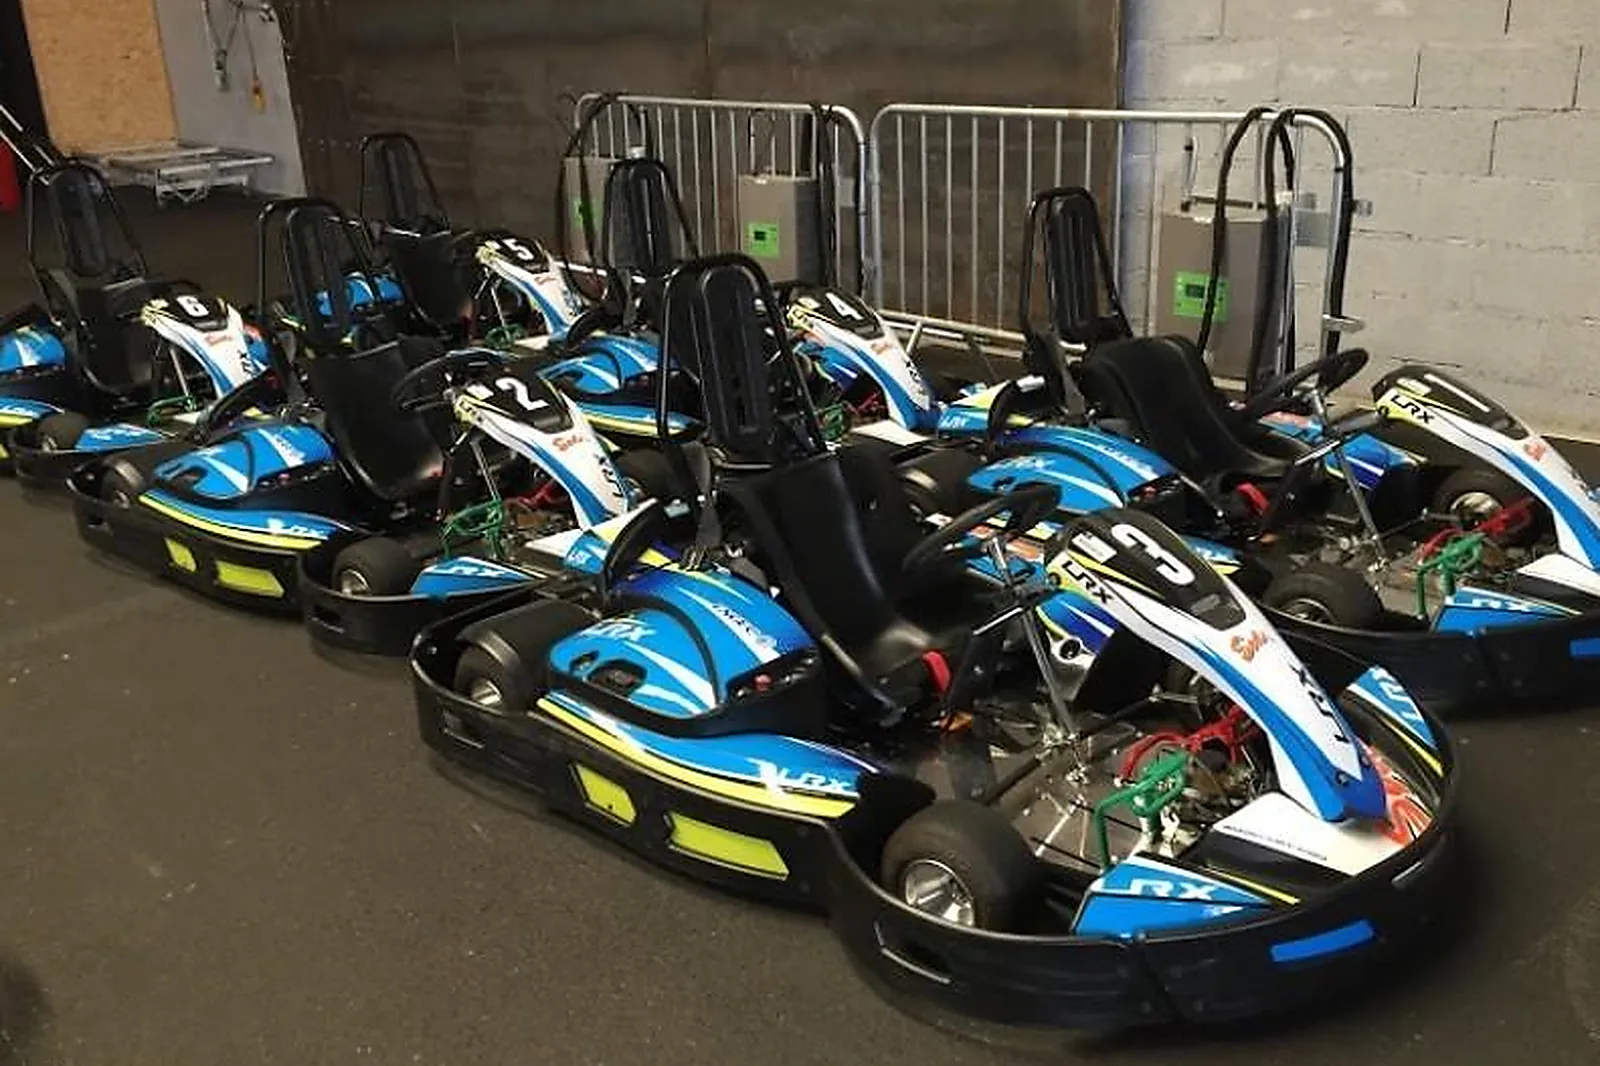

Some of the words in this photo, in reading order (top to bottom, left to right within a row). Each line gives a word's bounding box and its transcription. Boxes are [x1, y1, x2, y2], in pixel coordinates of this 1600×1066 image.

[503, 239, 534, 260] 5
[177, 295, 209, 317] 6
[826, 292, 863, 320] 4
[495, 377, 549, 410] 2
[1391, 395, 1435, 424] LRX
[1111, 524, 1195, 585] 3
[1061, 560, 1113, 603] LRX
